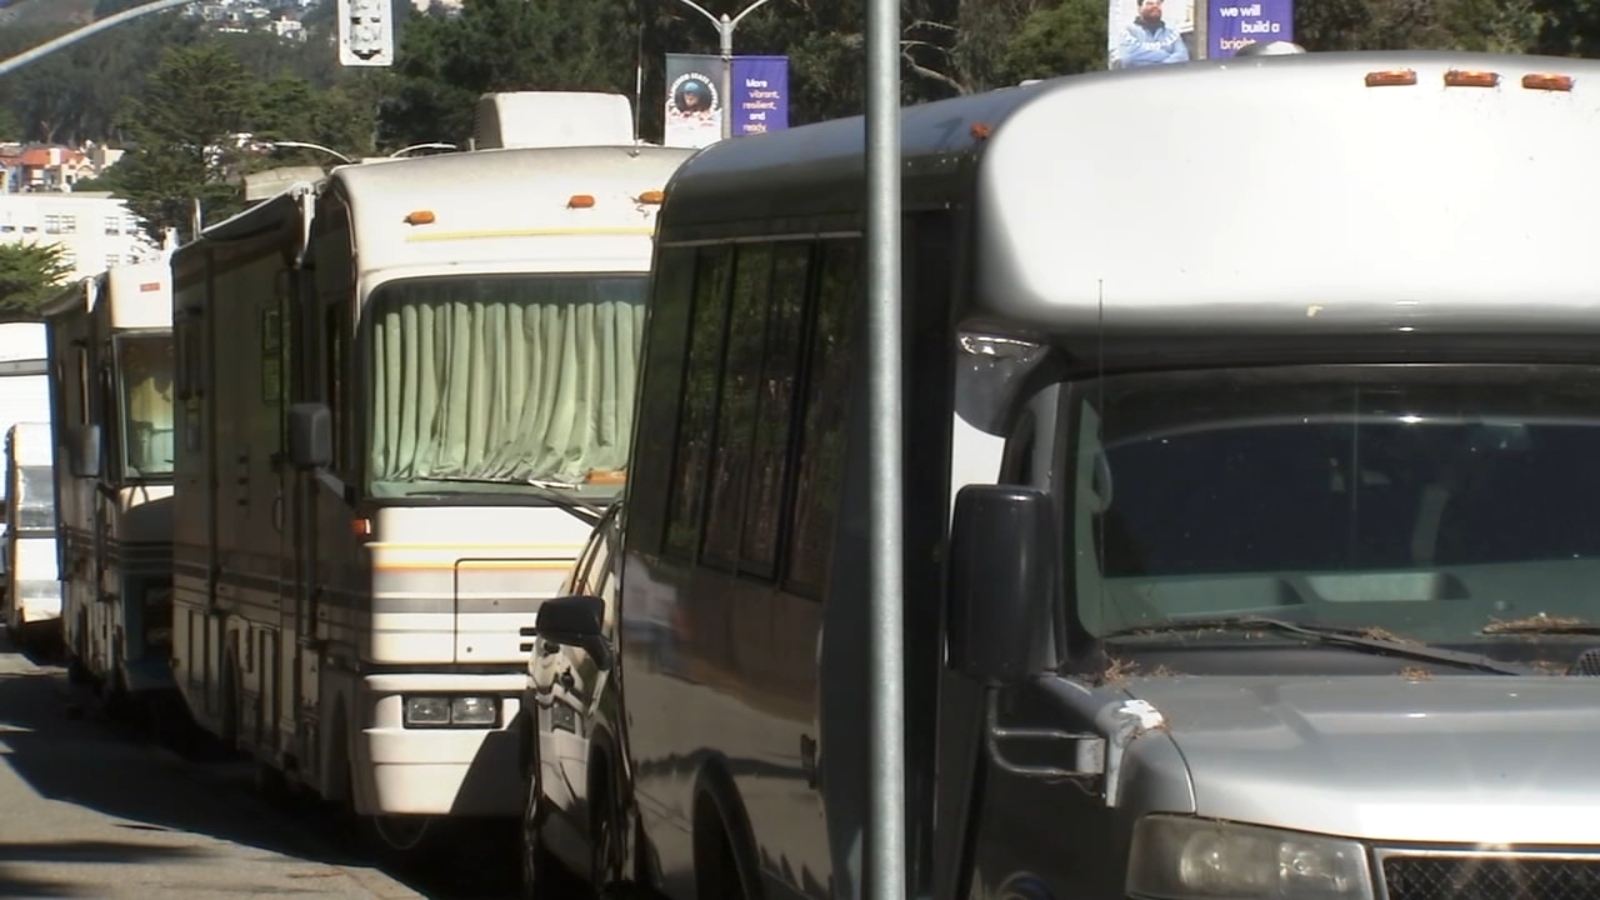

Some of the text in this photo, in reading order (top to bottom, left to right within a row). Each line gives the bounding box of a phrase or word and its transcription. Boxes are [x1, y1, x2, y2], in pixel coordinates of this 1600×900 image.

[1219, 4, 1261, 17] we will
[1241, 20, 1280, 33] build a
[745, 79, 768, 88] More
[749, 90, 780, 99] vibrant,
[743, 101, 777, 110] resilient,
[749, 111, 766, 121] and
